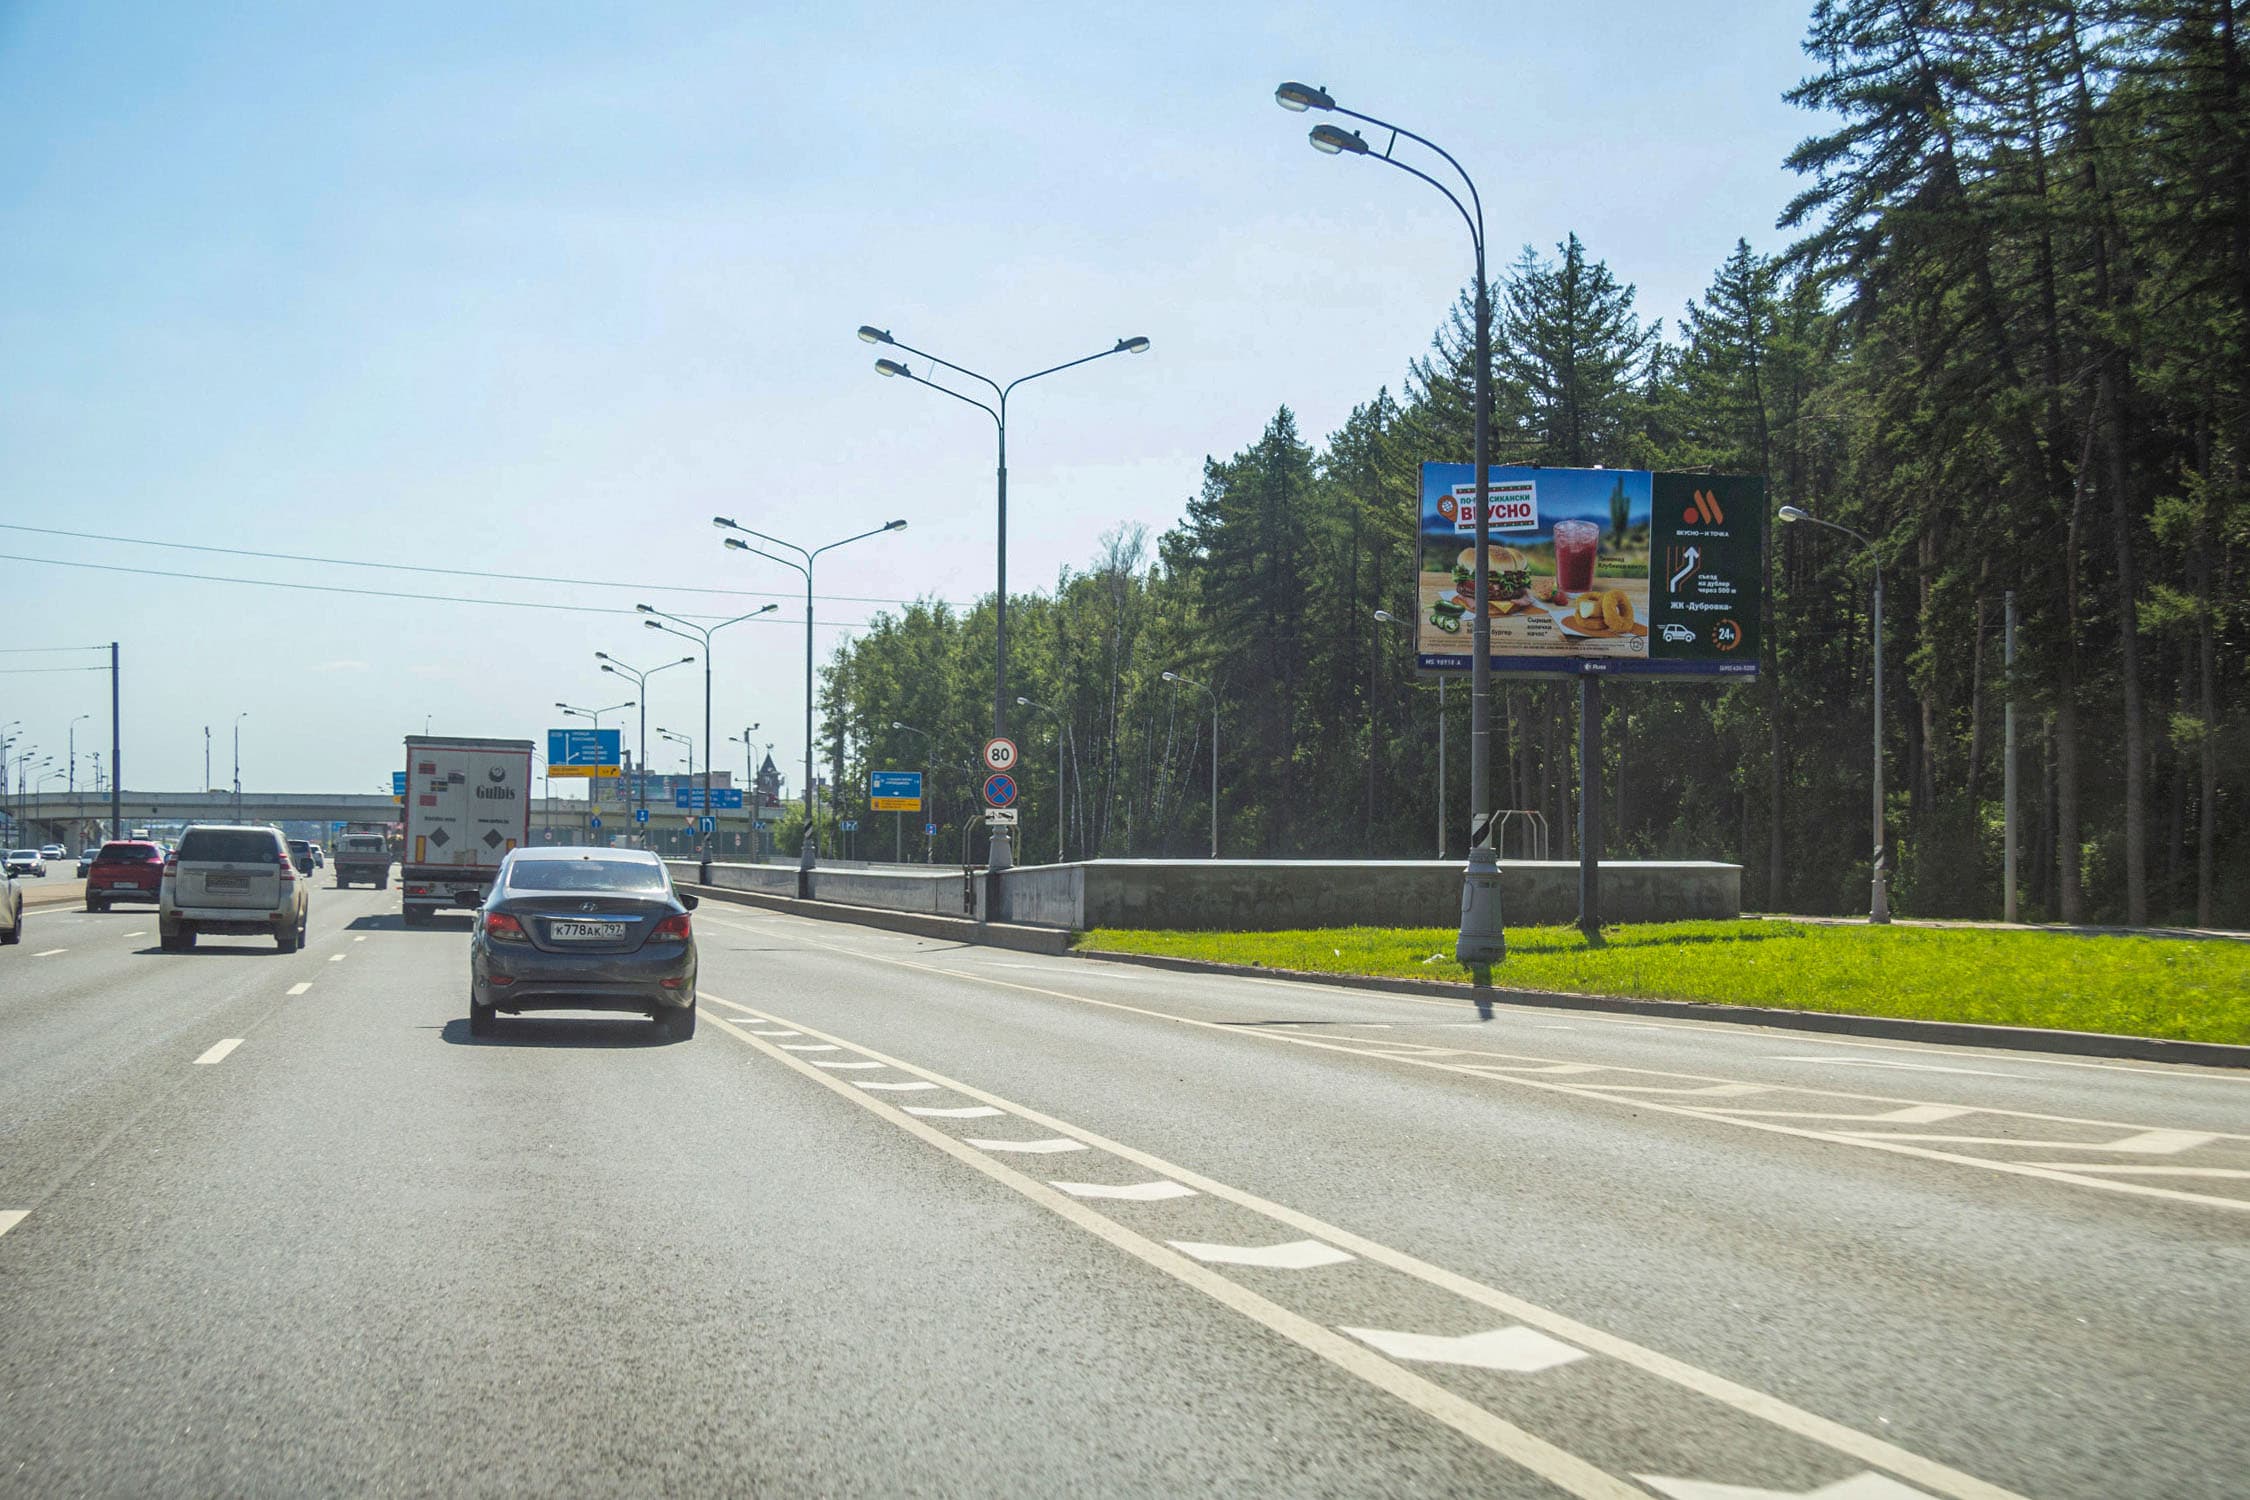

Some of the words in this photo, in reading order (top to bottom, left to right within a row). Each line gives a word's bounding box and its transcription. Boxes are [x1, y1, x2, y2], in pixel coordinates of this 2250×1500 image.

[1461, 503, 1531, 521] ВУСНО
[991, 748, 1009, 761] 80
[476, 785, 515, 800] Gulbis
[603, 924, 621, 934] 797
